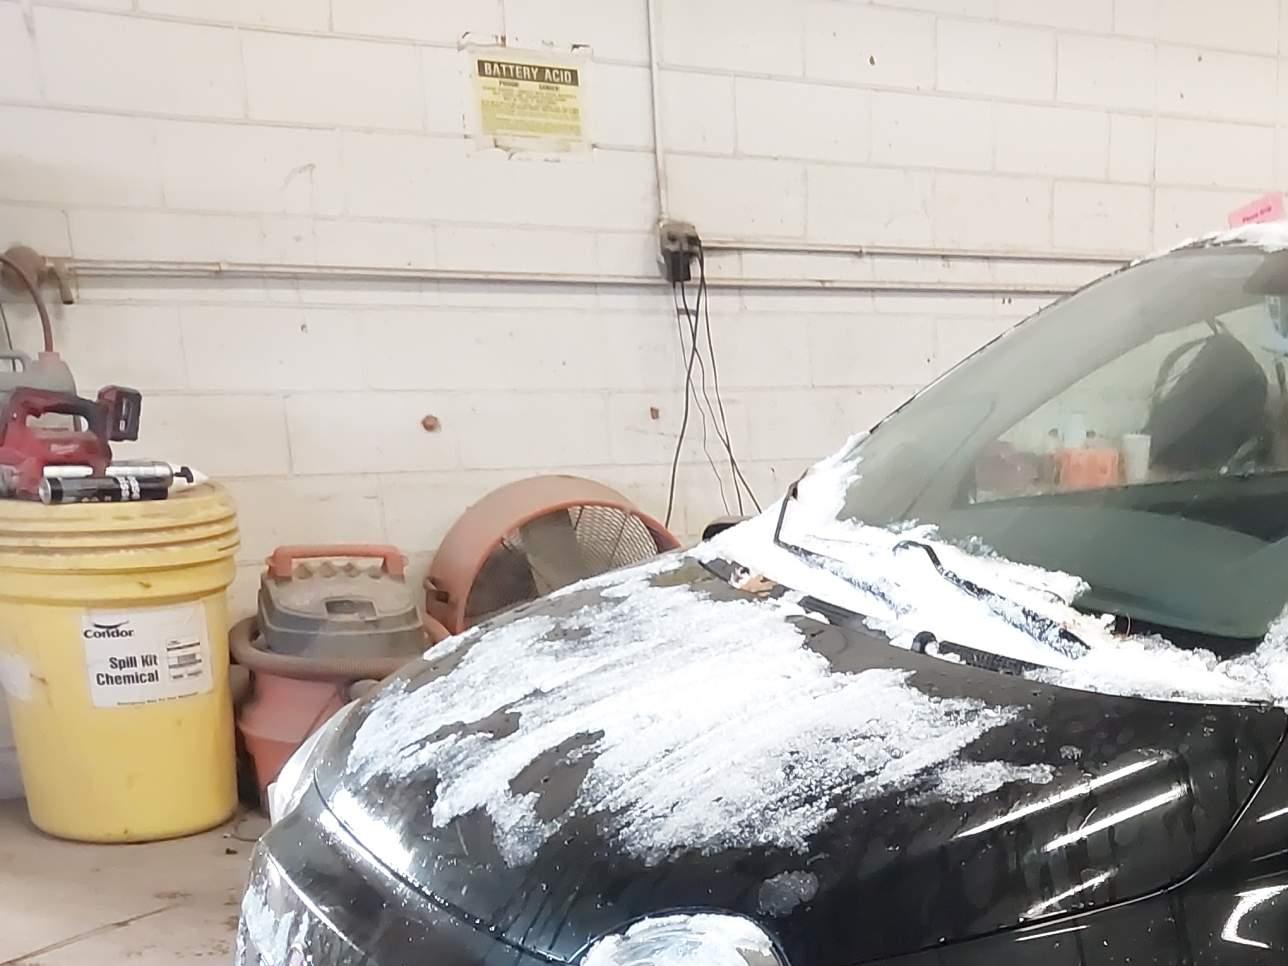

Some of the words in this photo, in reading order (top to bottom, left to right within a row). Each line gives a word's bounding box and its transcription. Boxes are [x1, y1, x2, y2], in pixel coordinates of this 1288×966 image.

[484, 62, 538, 80] BATTERY
[544, 68, 572, 83] ACID
[83, 628, 134, 639] Condor
[109, 656, 137, 671] Spill
[141, 654, 158, 666] Kit
[96, 670, 160, 686] Chemical
